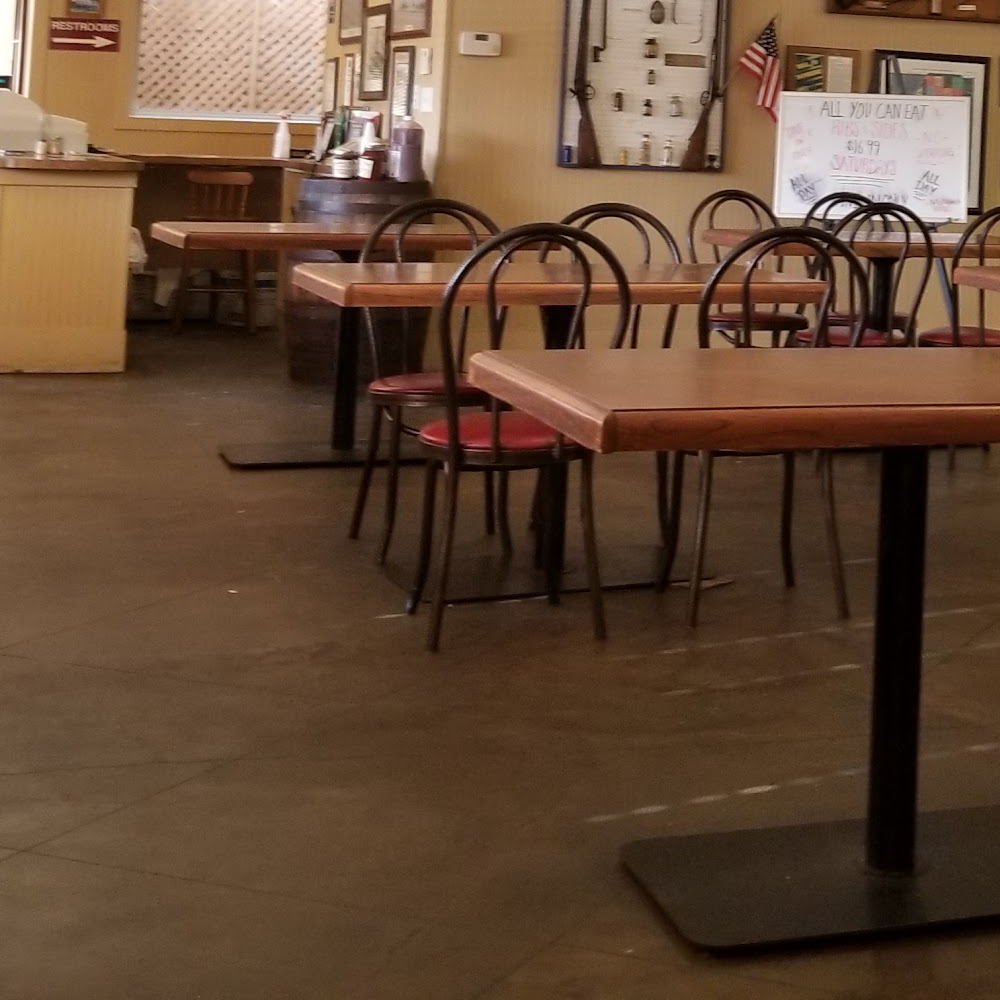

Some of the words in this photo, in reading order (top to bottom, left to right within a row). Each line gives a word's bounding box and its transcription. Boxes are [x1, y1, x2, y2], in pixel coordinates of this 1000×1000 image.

[51, 20, 120, 33] RESTROOMS
[820, 101, 844, 118] ALL
[849, 102, 872, 119] YOU
[876, 103, 901, 119] CAN
[904, 104, 929, 120] EAT
[831, 154, 896, 175] SATURDAYS
[790, 173, 809, 192] ALL
[915, 180, 938, 194] DAY
[921, 171, 940, 187] ALL
[798, 184, 816, 200] DAY
